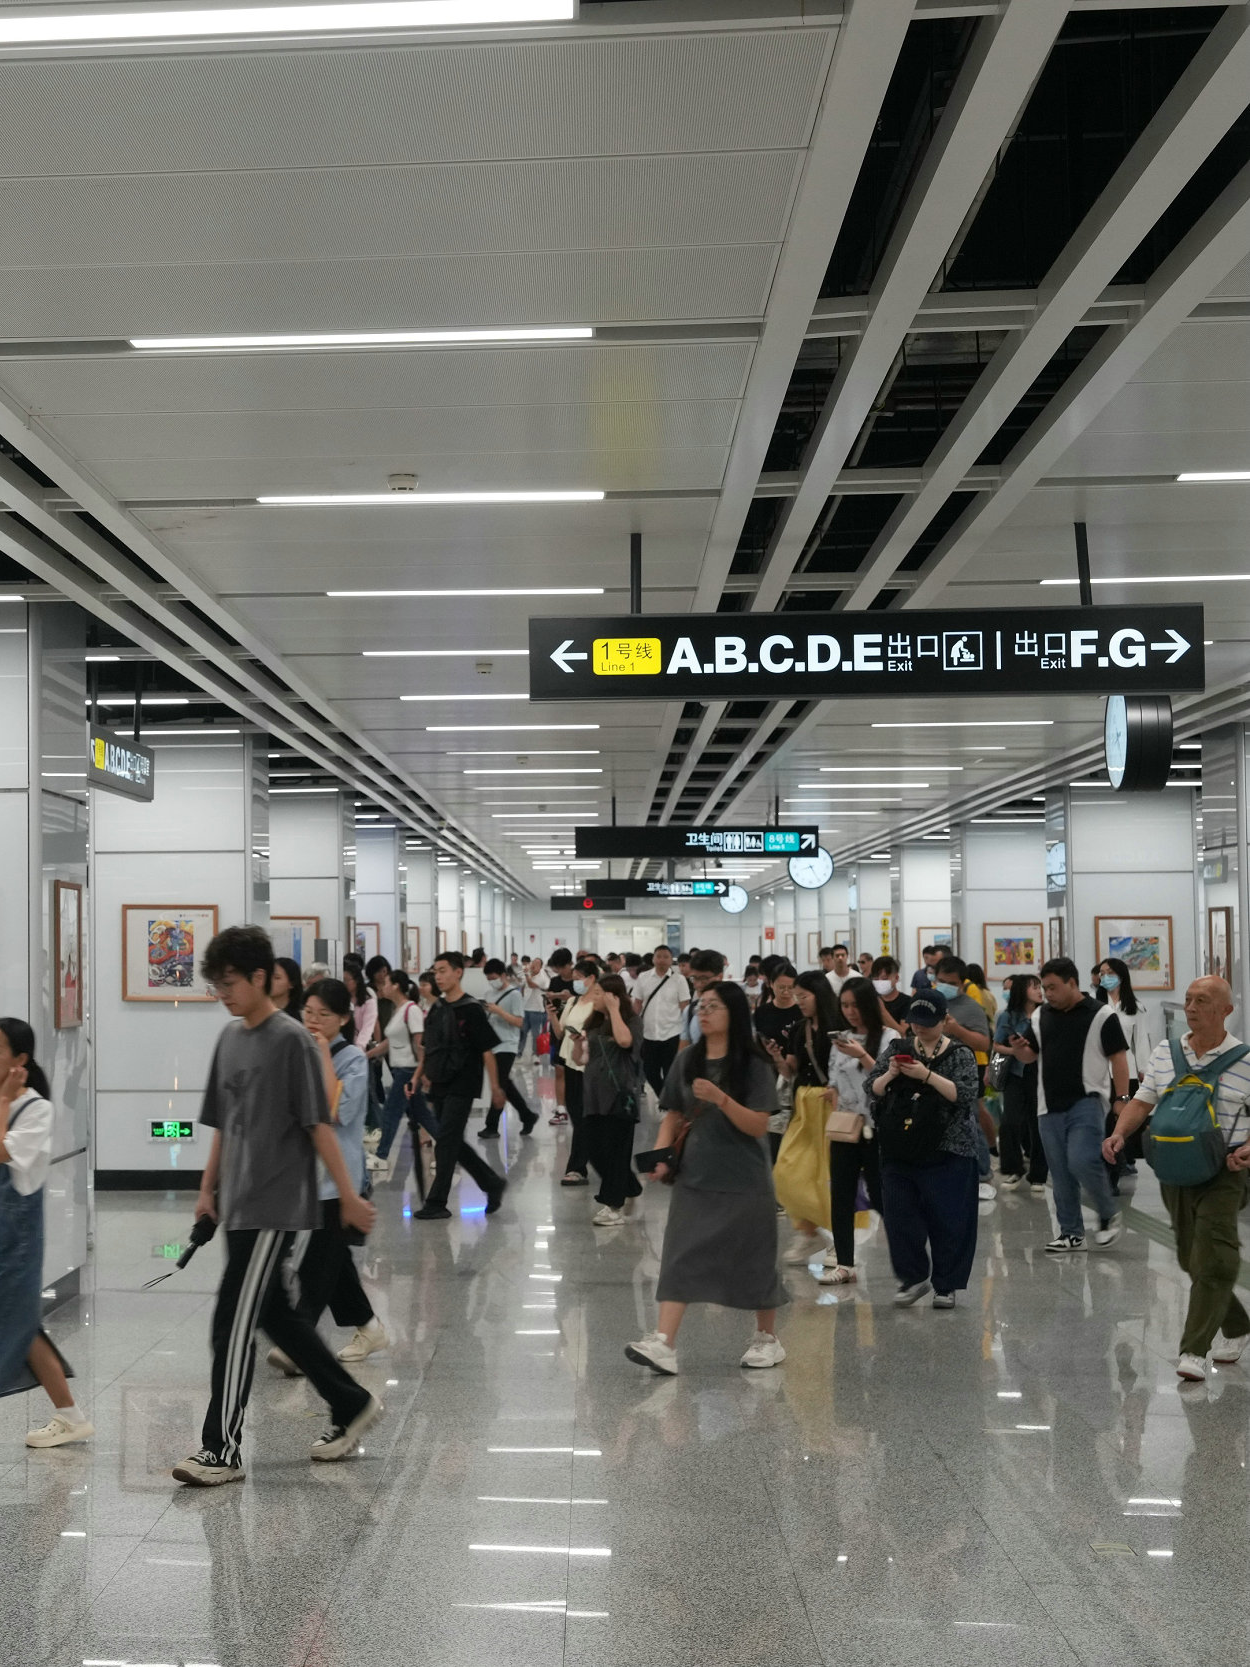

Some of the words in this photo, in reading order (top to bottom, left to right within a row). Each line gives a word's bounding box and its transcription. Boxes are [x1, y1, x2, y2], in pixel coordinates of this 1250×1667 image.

[601, 641, 653, 660] 1号线
[887, 632, 939, 659] 出口
[1014, 630, 1066, 657] 出口
[1070, 628, 1146, 668] F.G
[666, 634, 884, 674] A.B.C.D.E
[601, 662, 626, 672] Line
[630, 662, 635, 672] 1
[887, 660, 913, 672] Exit
[1040, 657, 1066, 669] Exit
[685, 832, 723, 846] 卫生间
[768, 834, 796, 845] 8号线
